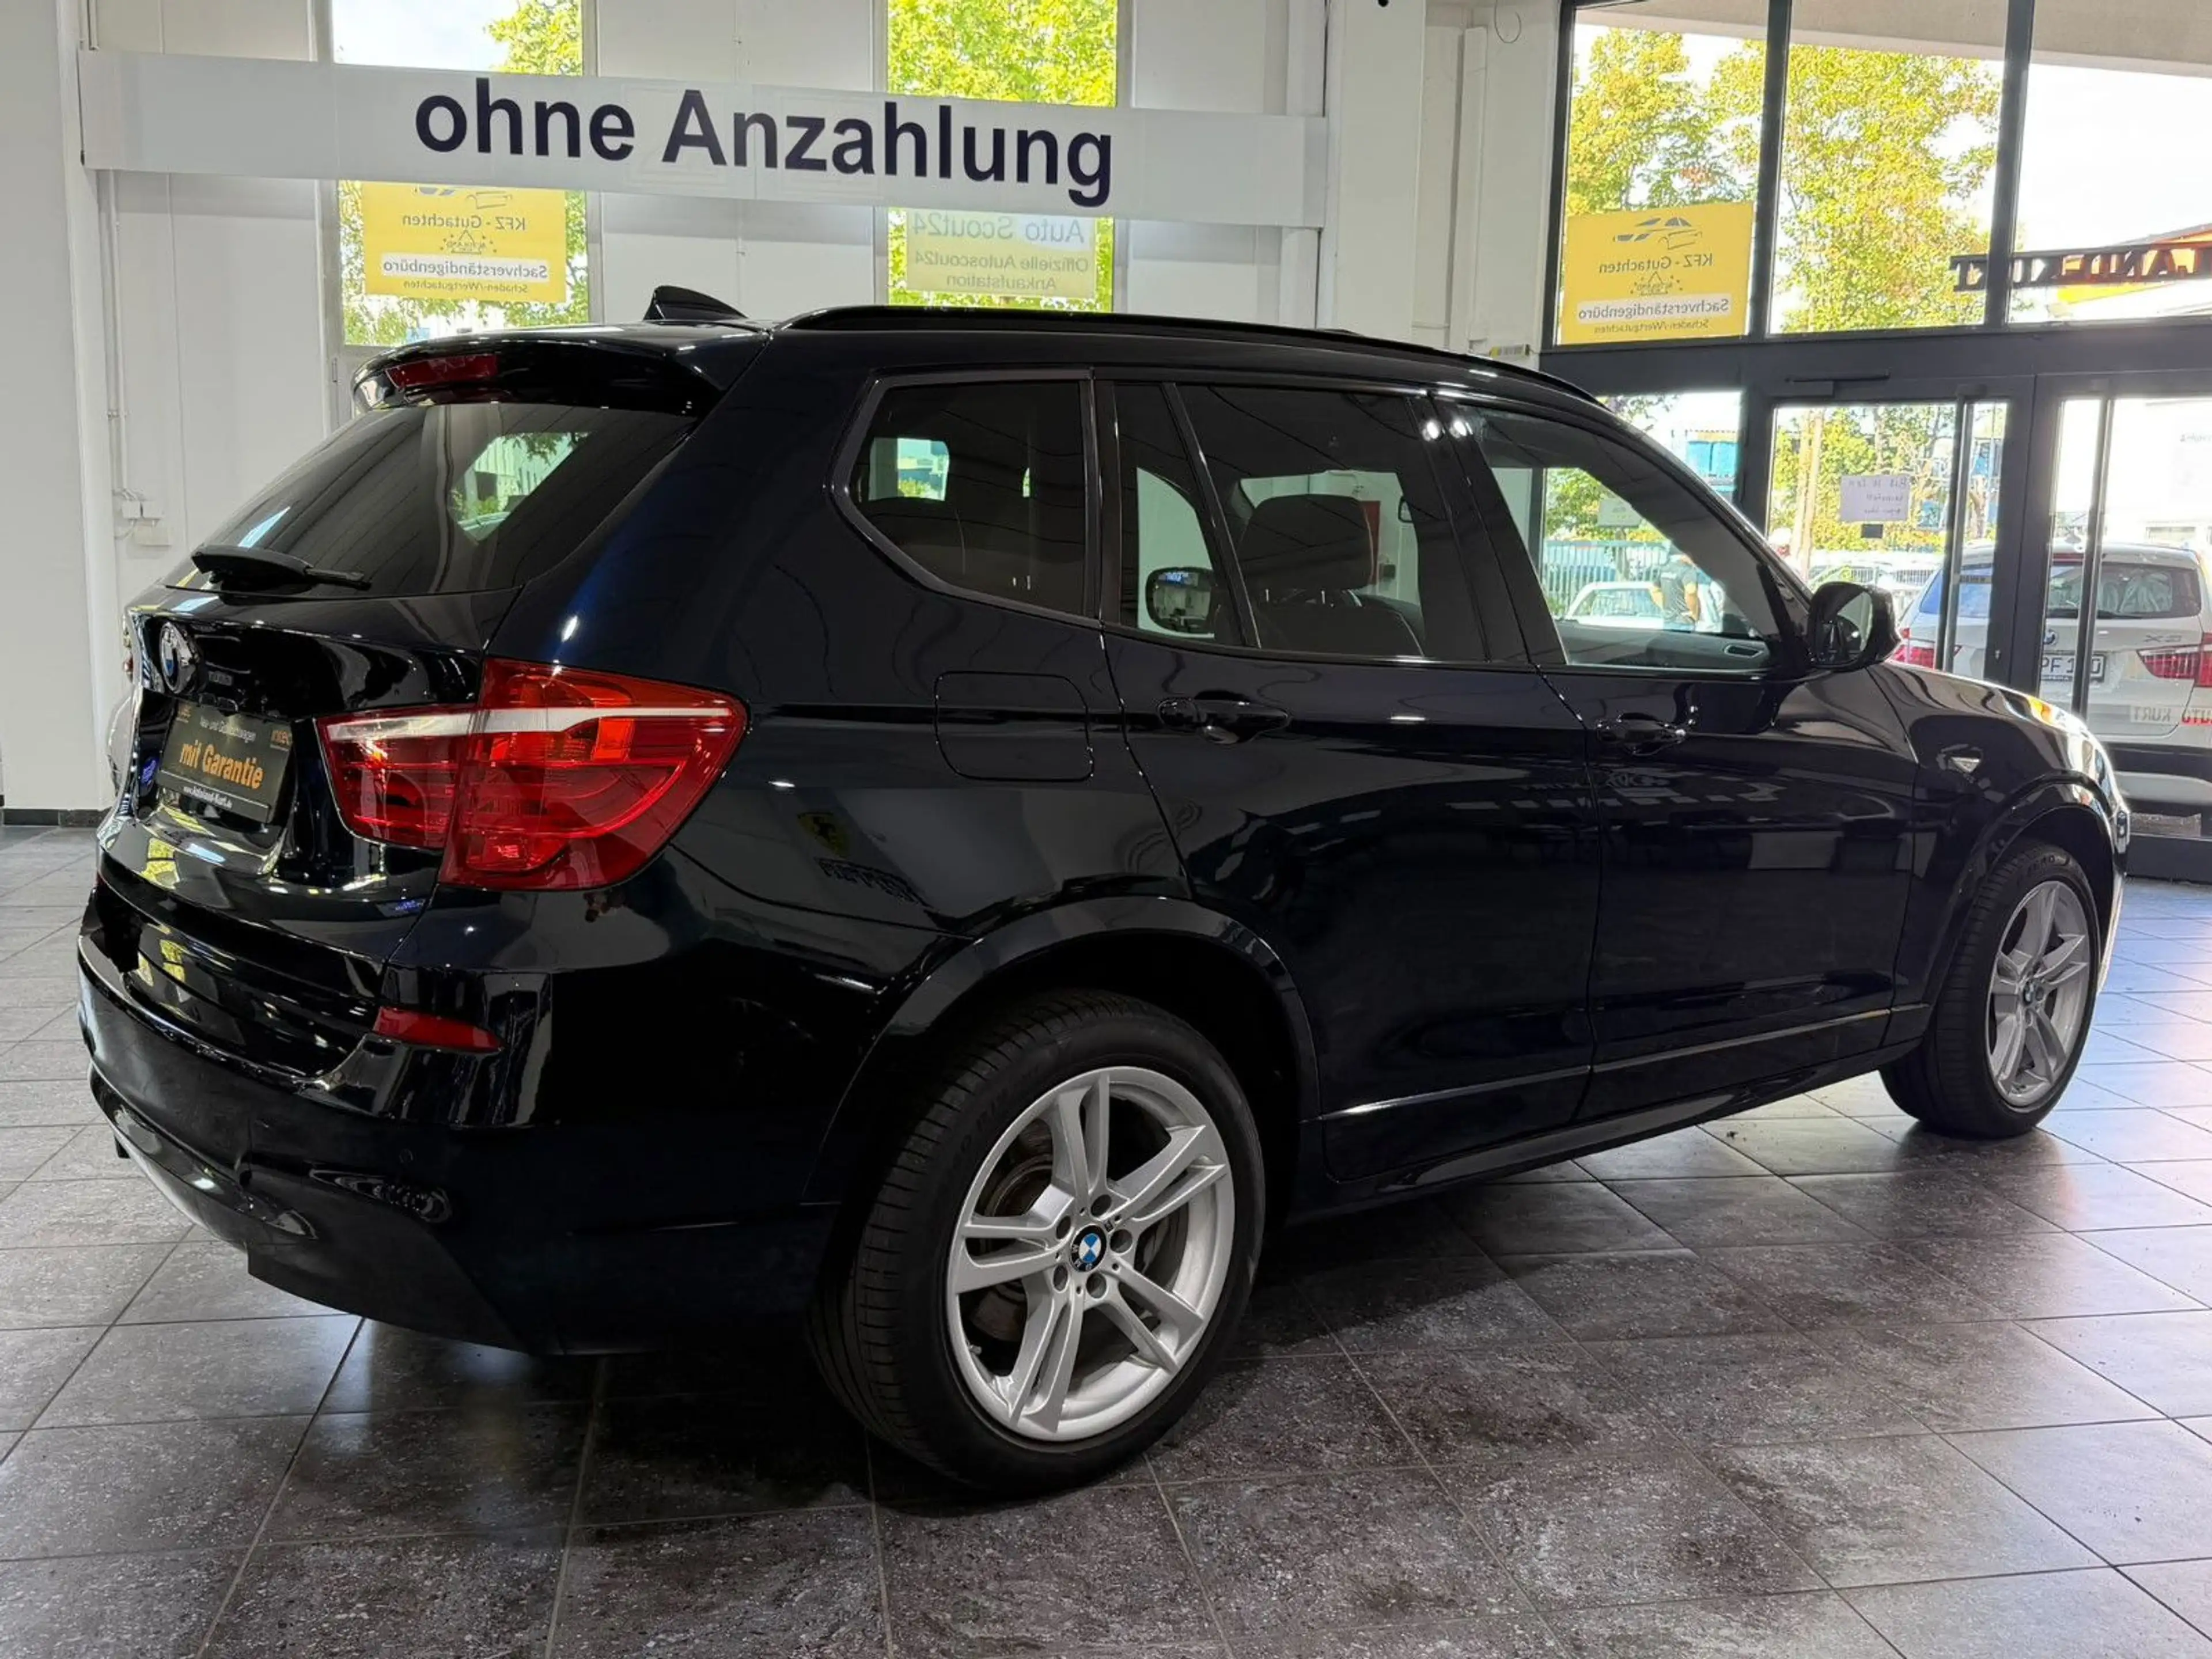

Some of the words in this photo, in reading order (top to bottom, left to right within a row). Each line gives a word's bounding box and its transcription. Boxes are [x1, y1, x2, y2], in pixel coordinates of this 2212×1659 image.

[415, 78, 635, 161] ohne
[662, 89, 1112, 207] Anzahlung
[179, 740, 202, 768] mit
[203, 744, 264, 790] Garantie
